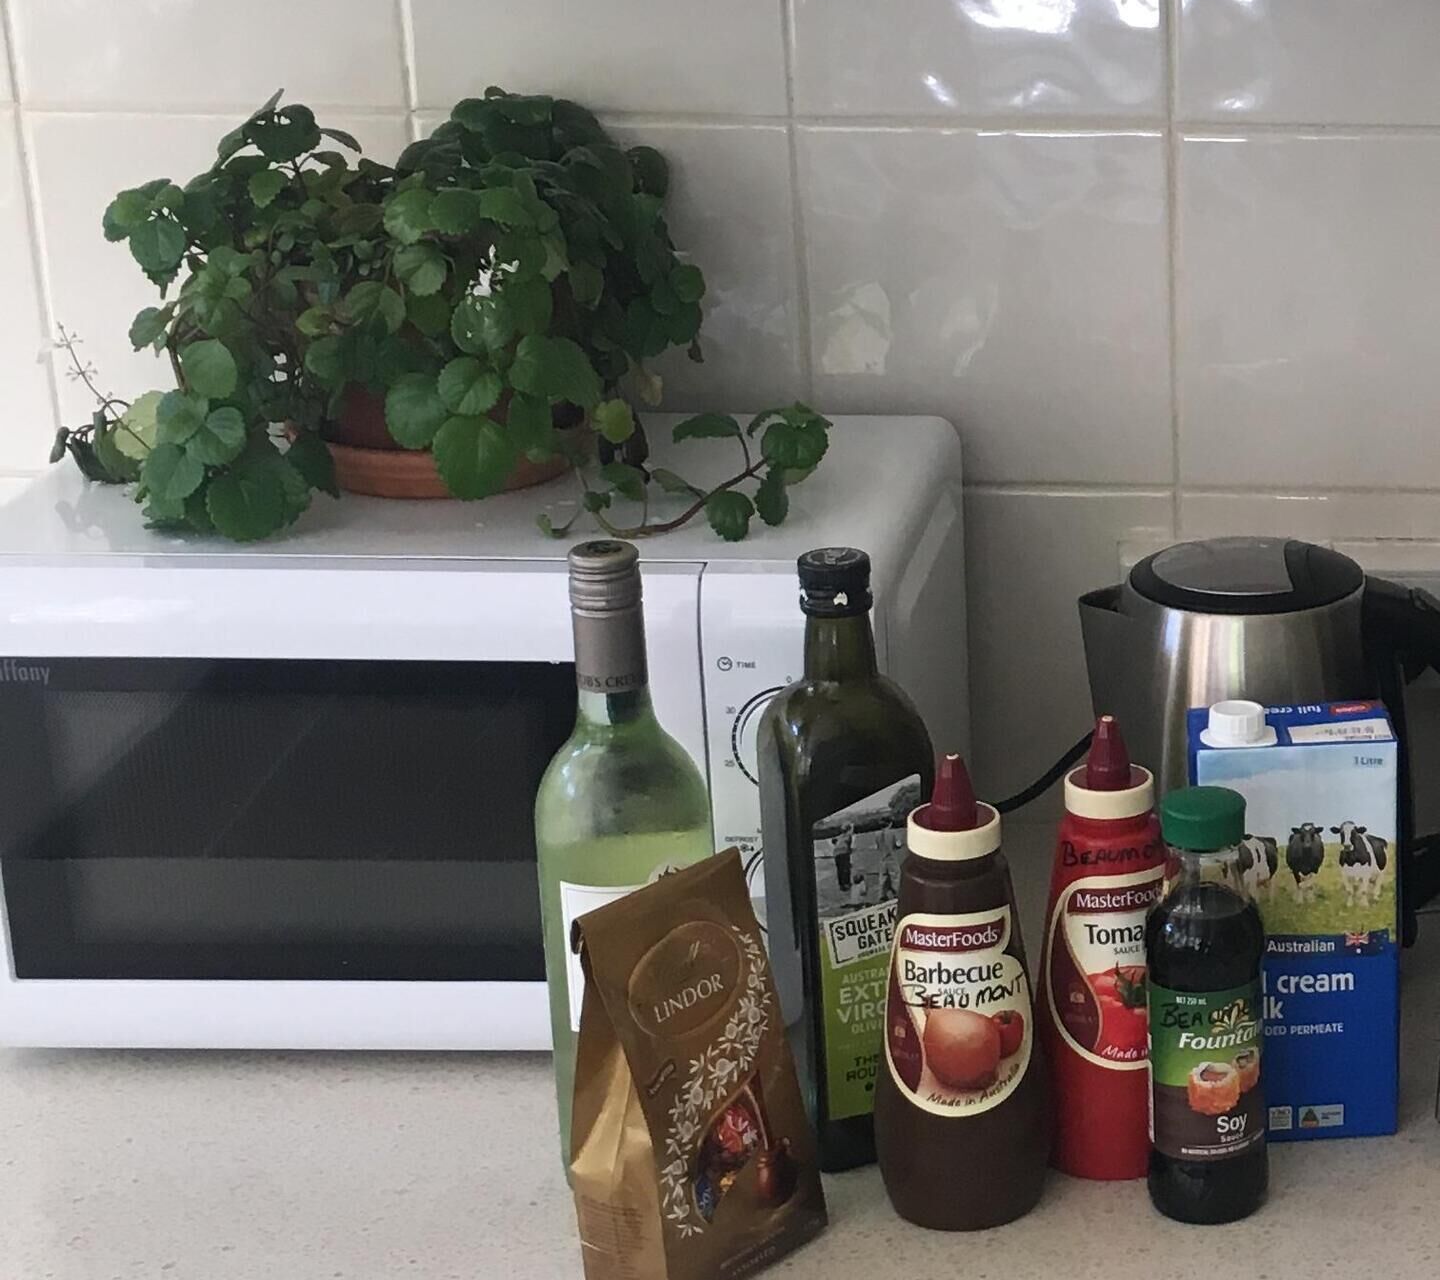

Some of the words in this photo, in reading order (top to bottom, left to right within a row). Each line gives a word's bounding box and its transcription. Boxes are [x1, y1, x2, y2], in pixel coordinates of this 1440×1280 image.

[834, 906, 898, 942] SQUEAK
[1083, 923, 1145, 946] Toma
[905, 927, 999, 948] MasterFoods
[1266, 939, 1336, 954] Australian
[1113, 943, 1141, 955] SAUCE
[841, 967, 891, 985] AUSTRA
[904, 959, 1004, 985] Barbecue
[1276, 971, 1355, 994] cream
[653, 972, 725, 1024] LINDOR
[839, 979, 890, 1006] EXT
[1262, 995, 1284, 1020] lk
[1264, 1024, 1287, 1037] DED
[1290, 1022, 1345, 1036] PERMEATE
[1101, 1045, 1138, 1059] Made
[845, 1065, 877, 1083] ROU
[926, 1093, 961, 1108] Made
[964, 1097, 976, 1106] in
[979, 1062, 1021, 1104] Australia
[1216, 1112, 1248, 1134] Soy
[1220, 1131, 1244, 1144] Sauce
